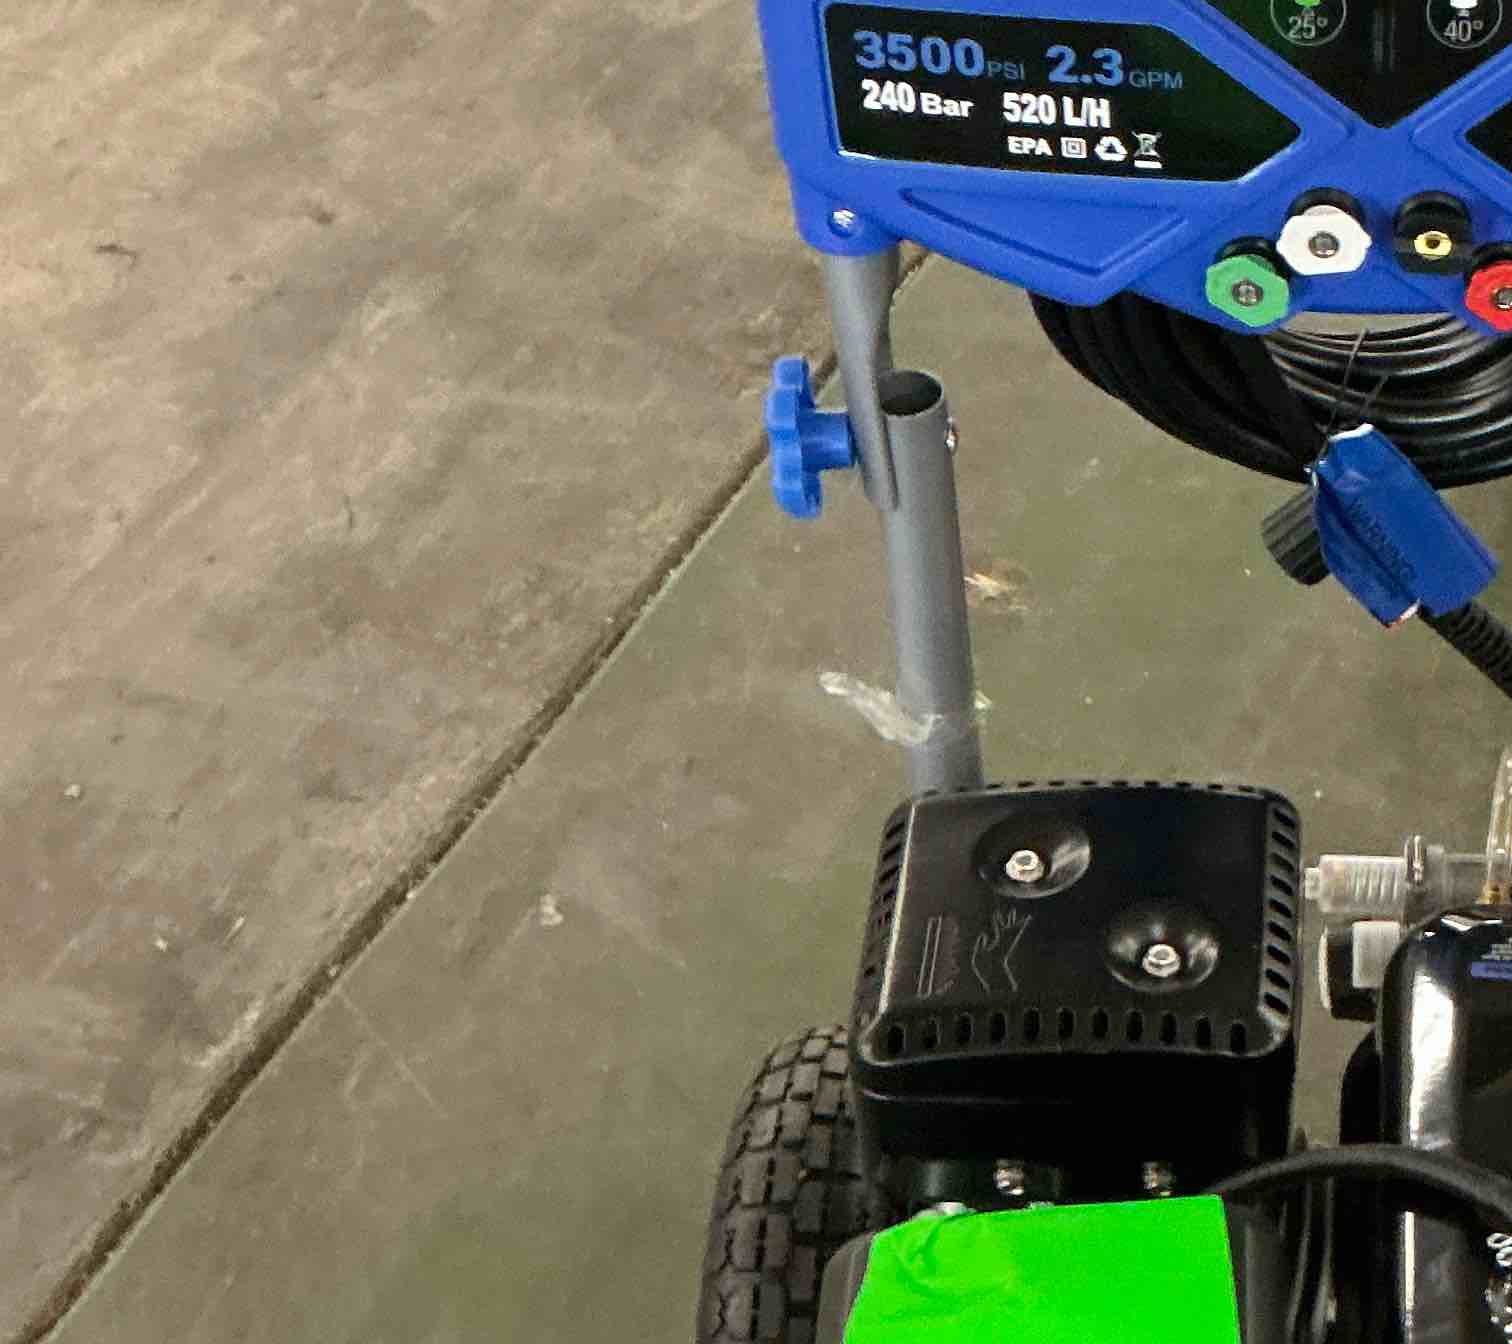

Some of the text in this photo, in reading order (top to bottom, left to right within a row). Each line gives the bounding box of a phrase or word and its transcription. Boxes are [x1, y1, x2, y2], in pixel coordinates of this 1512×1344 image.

[853, 30, 985, 77] 3500
[1046, 45, 1125, 86] 2.3
[1128, 69, 1184, 90] GPM
[862, 79, 916, 113] 240
[922, 92, 974, 119] Bar
[1003, 92, 1056, 125] 520
[1008, 136, 1053, 158] EPA
